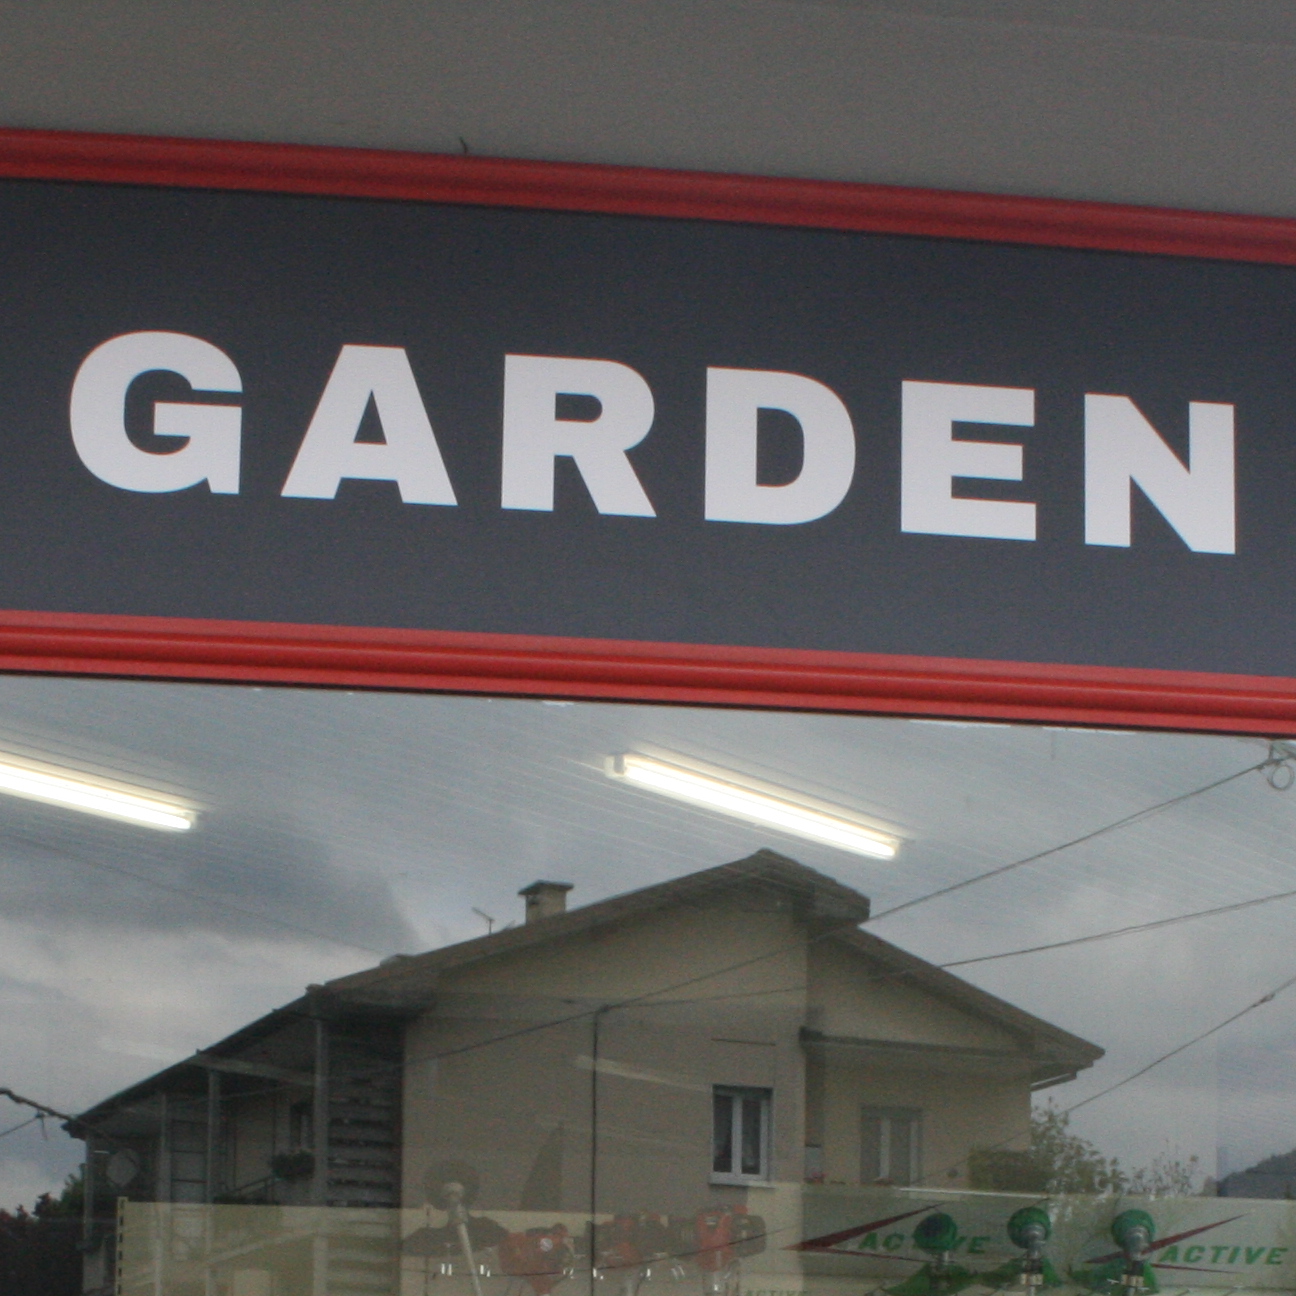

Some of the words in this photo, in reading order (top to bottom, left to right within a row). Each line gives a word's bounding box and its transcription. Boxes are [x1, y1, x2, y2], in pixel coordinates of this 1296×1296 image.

[69, 330, 1236, 555] GARDEN
[859, 1231, 991, 1255] ACVE
[1161, 1244, 1289, 1266] ACTIVE
